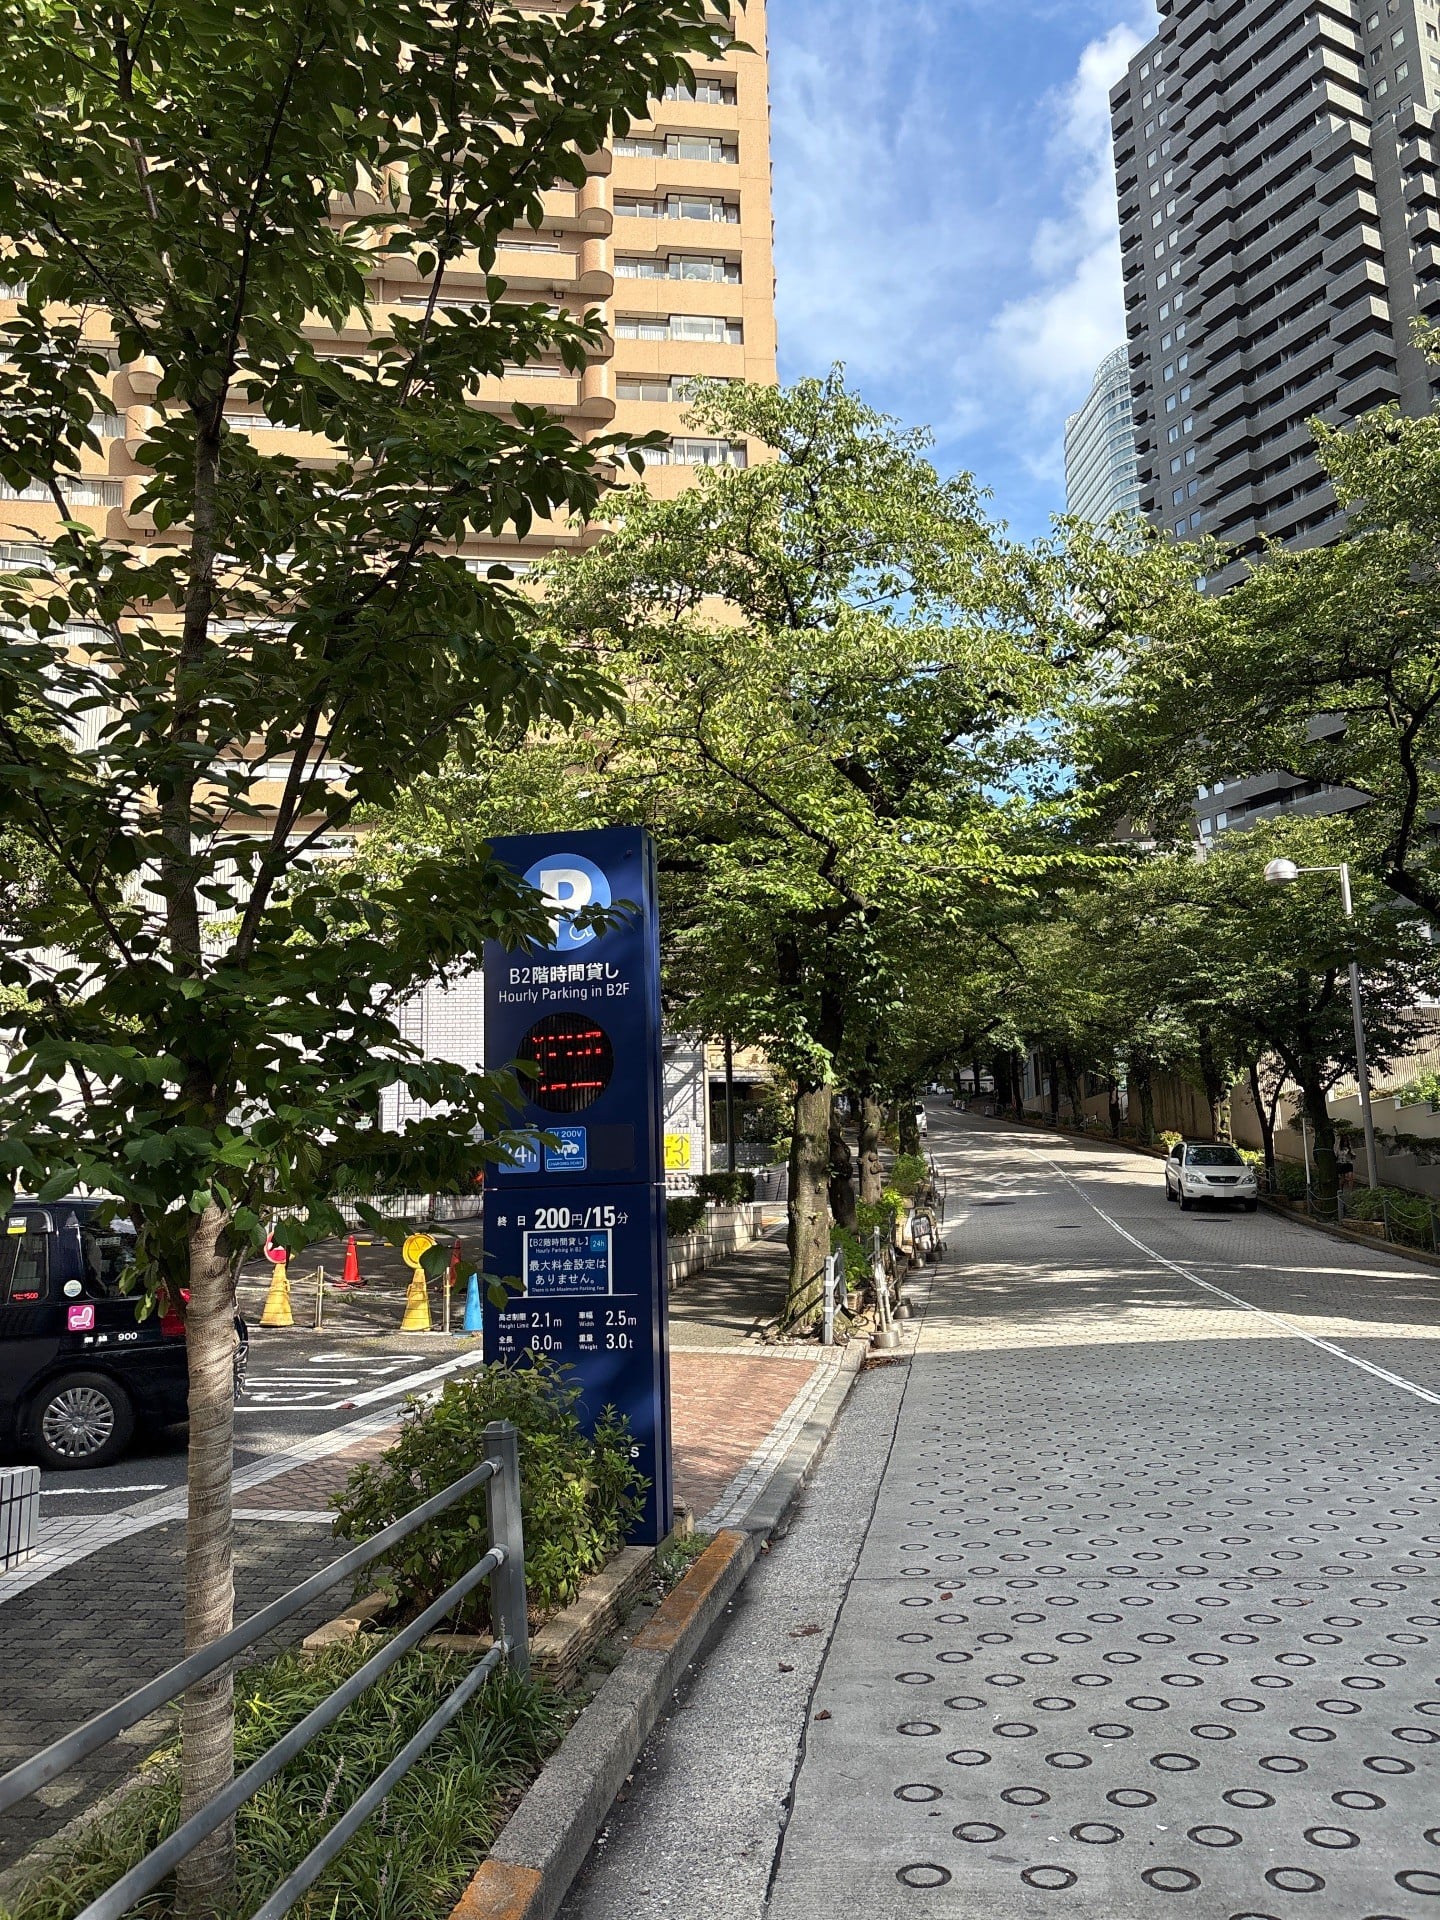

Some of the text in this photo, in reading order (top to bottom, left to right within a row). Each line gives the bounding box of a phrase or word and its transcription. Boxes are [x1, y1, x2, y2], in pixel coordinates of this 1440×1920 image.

[540, 869, 592, 937] P
[510, 962, 619, 985] B2階時間貸し
[499, 982, 630, 1003] Hourly Parking in B2F
[561, 1130, 582, 1138] 200V
[592, 1239, 605, 1248] 24h
[529, 1258, 607, 1272] 最大料金設定は
[535, 1273, 595, 1286] ありません。
[118, 1332, 138, 1341] 900
